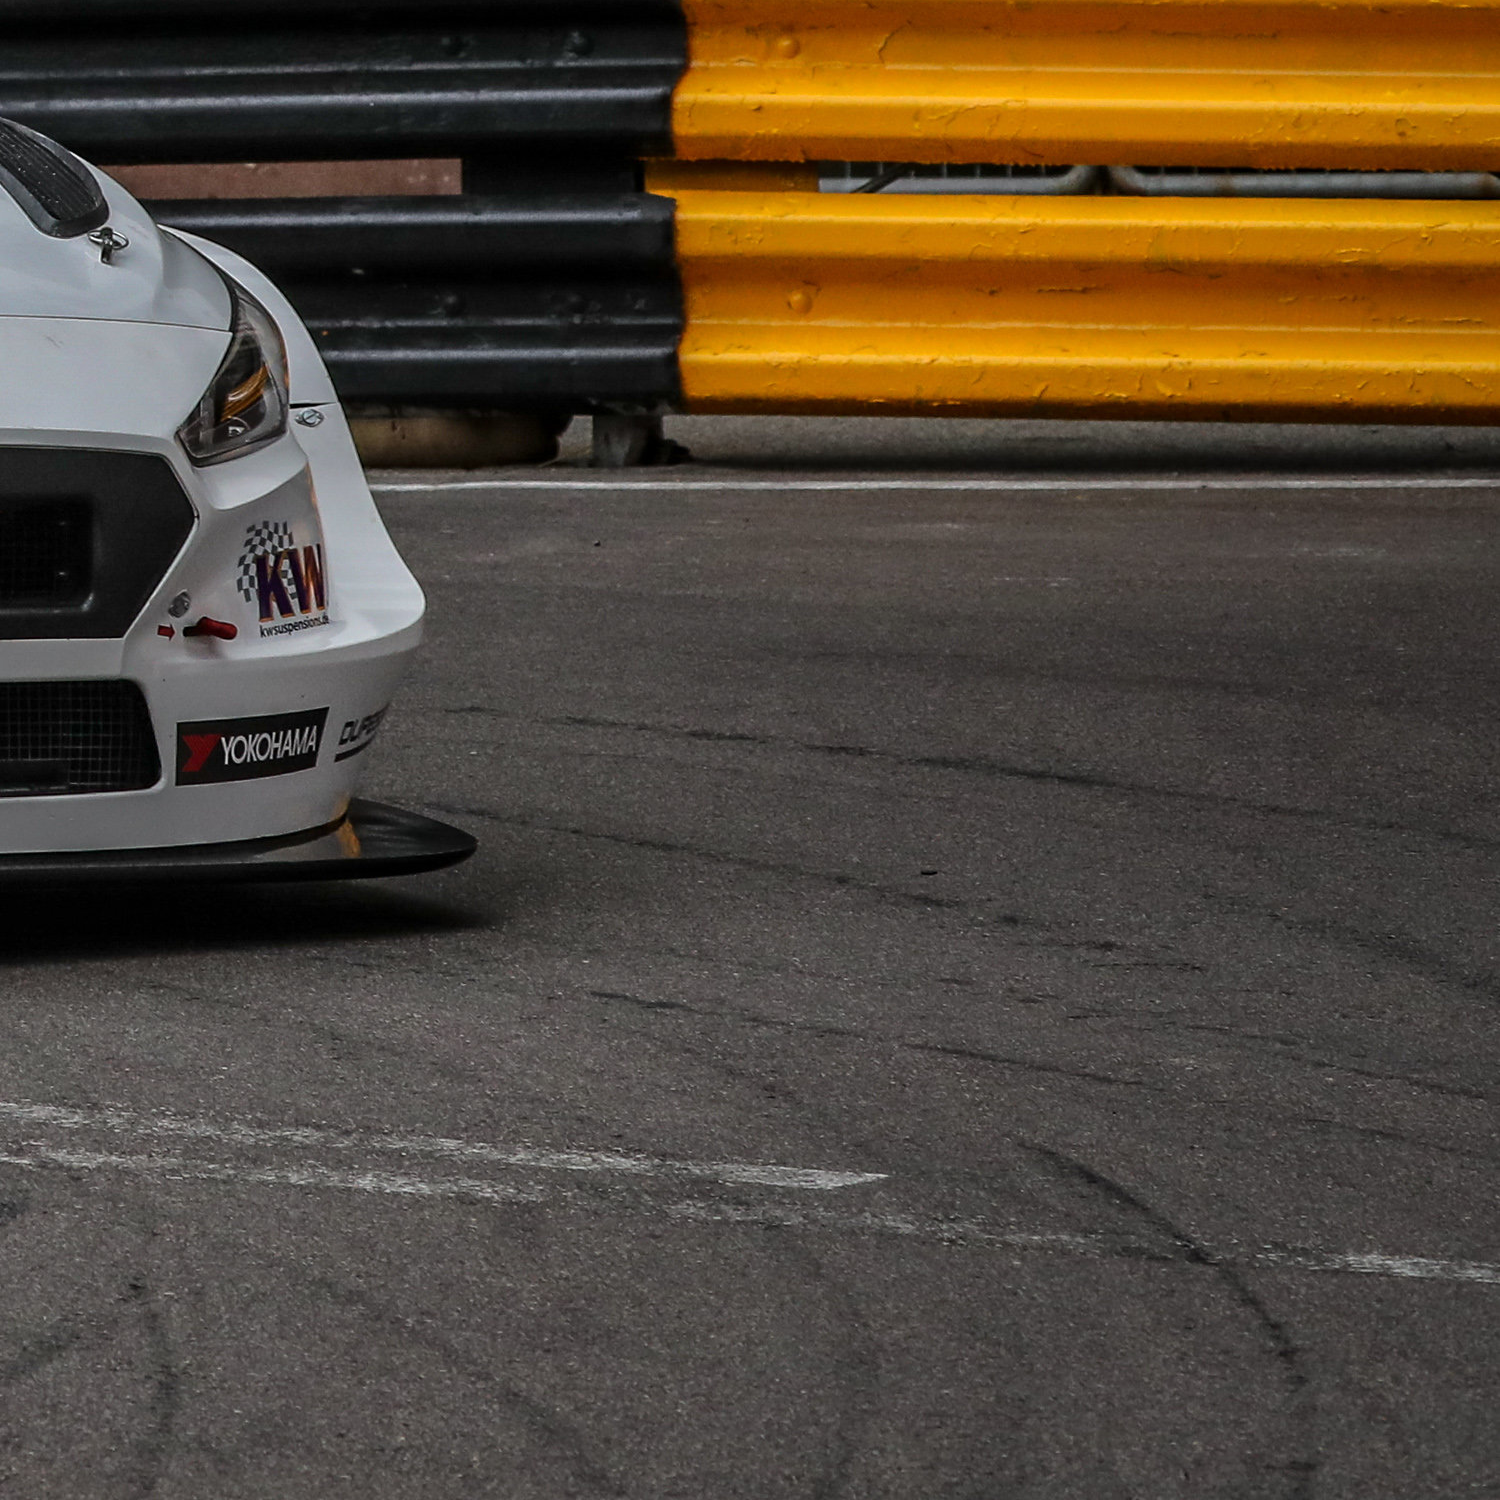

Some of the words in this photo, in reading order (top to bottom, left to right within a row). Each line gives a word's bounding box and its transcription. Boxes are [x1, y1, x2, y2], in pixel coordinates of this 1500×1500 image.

[255, 543, 326, 623] KW
[258, 610, 331, 639] kwsuspensions.de
[220, 724, 318, 767] YOKOHAMA
